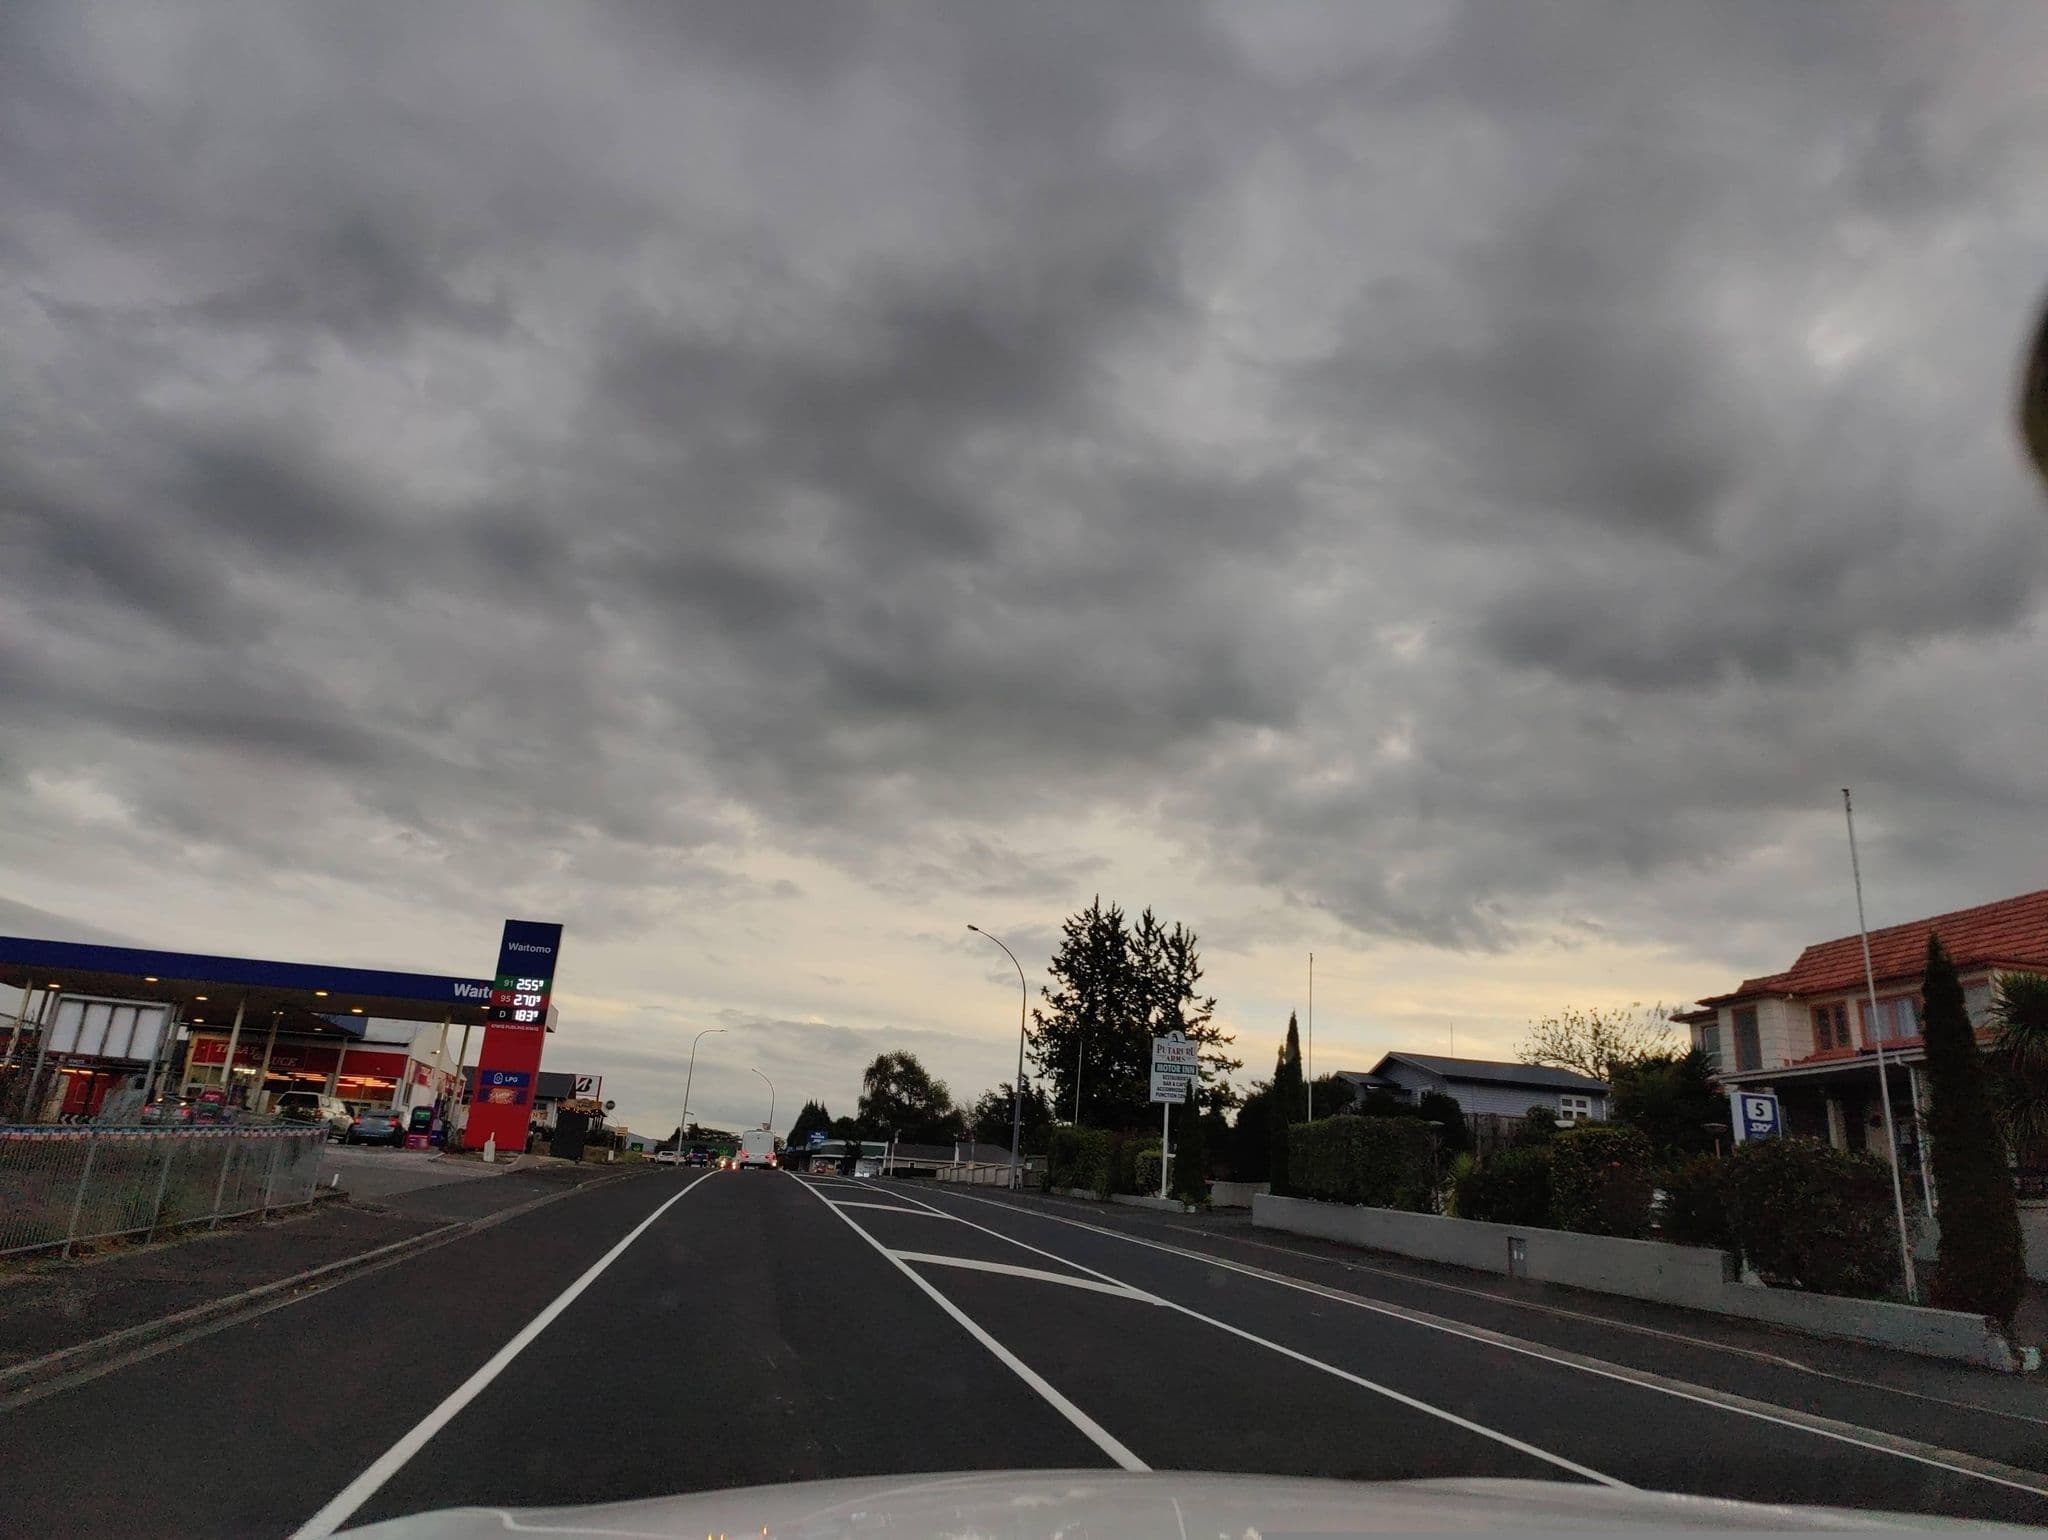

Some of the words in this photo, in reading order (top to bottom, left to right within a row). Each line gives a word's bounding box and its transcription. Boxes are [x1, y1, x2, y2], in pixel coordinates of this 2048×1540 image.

[508, 942, 552, 954] Waitomo
[500, 995, 511, 1003] 95
[499, 1010, 506, 1018] D
[1157, 1064, 1181, 1073] MOTOR
[1182, 1066, 1195, 1075] INN
[1755, 1102, 1765, 1117] 5
